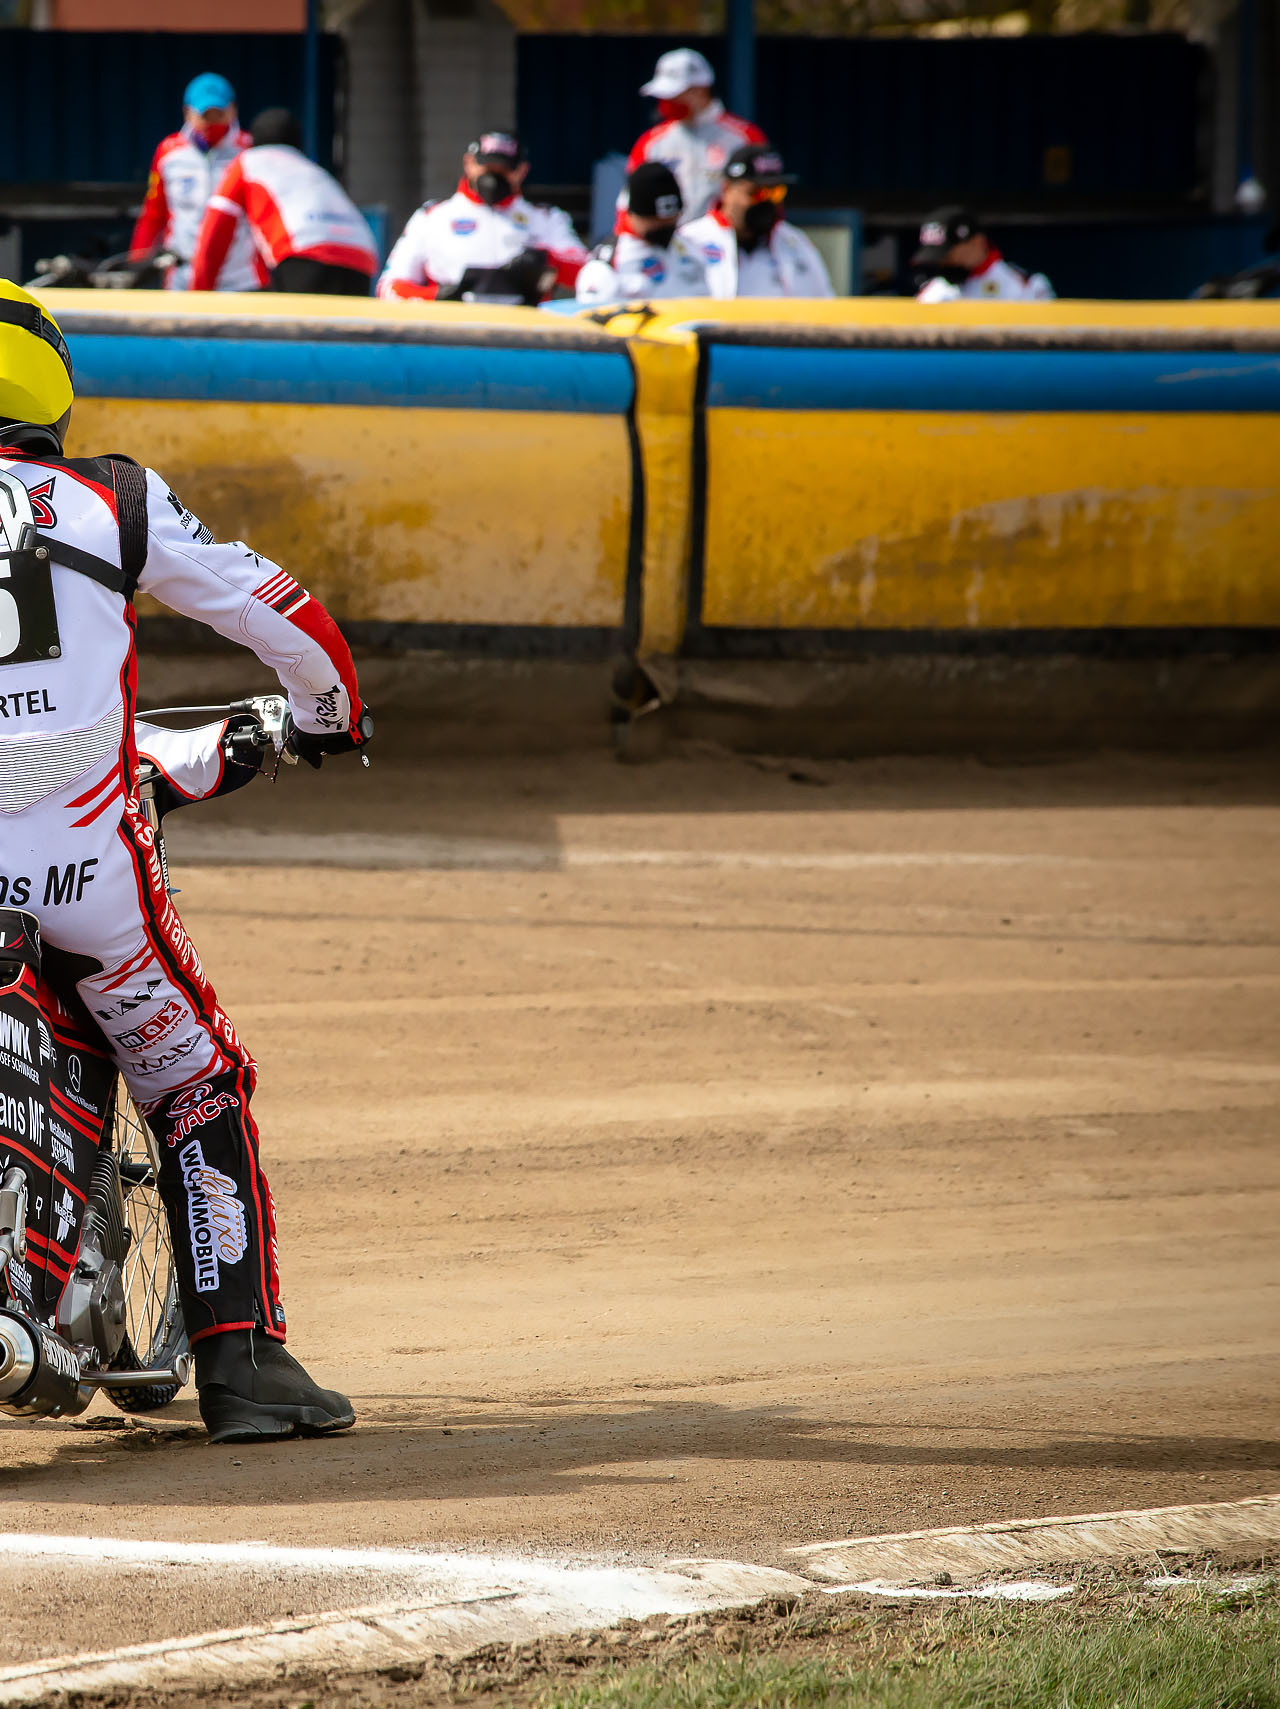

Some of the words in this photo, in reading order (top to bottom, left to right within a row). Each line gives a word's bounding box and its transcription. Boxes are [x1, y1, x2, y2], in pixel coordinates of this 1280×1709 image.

[43, 858, 99, 906] MF
[95, 979, 163, 1020] HÄSA
[115, 1001, 182, 1049] max
[128, 1010, 189, 1054] Werbung
[11, 1056, 40, 1085] SCHWAIGER
[29, 1096, 45, 1147] MF
